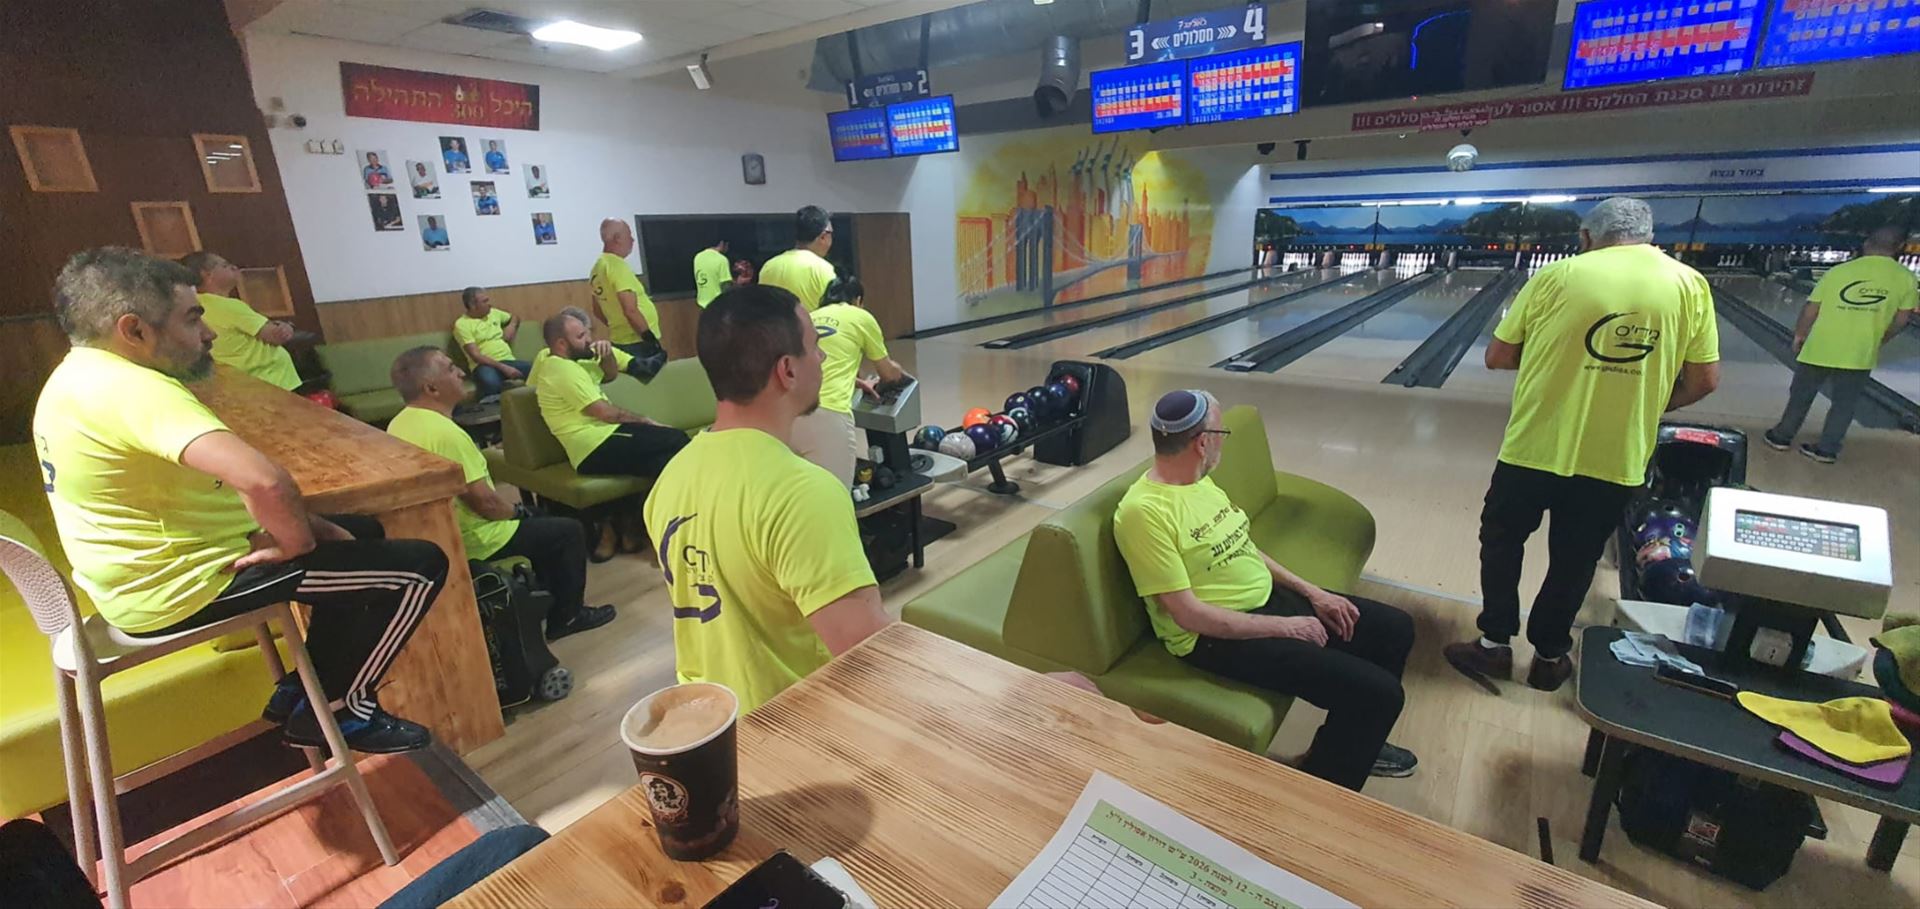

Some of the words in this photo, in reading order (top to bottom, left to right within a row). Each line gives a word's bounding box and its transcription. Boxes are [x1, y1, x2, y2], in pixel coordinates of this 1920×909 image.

[1130, 29, 1144, 60] 3
[1173, 27, 1213, 48] מסלולים
[1243, 8, 1264, 40] 4
[917, 70, 929, 95] 2
[1740, 79, 1806, 97] זהירות
[353, 79, 441, 108] התהילה
[849, 82, 858, 104] 1
[1587, 91, 1648, 110] החלקה
[1655, 88, 1702, 102] סכנת
[490, 90, 532, 116] היכל
[1520, 100, 1557, 114] אסור
[1187, 854, 1211, 873] 2026
[1189, 870, 1198, 880] 3
[1235, 881, 1248, 893] 12
